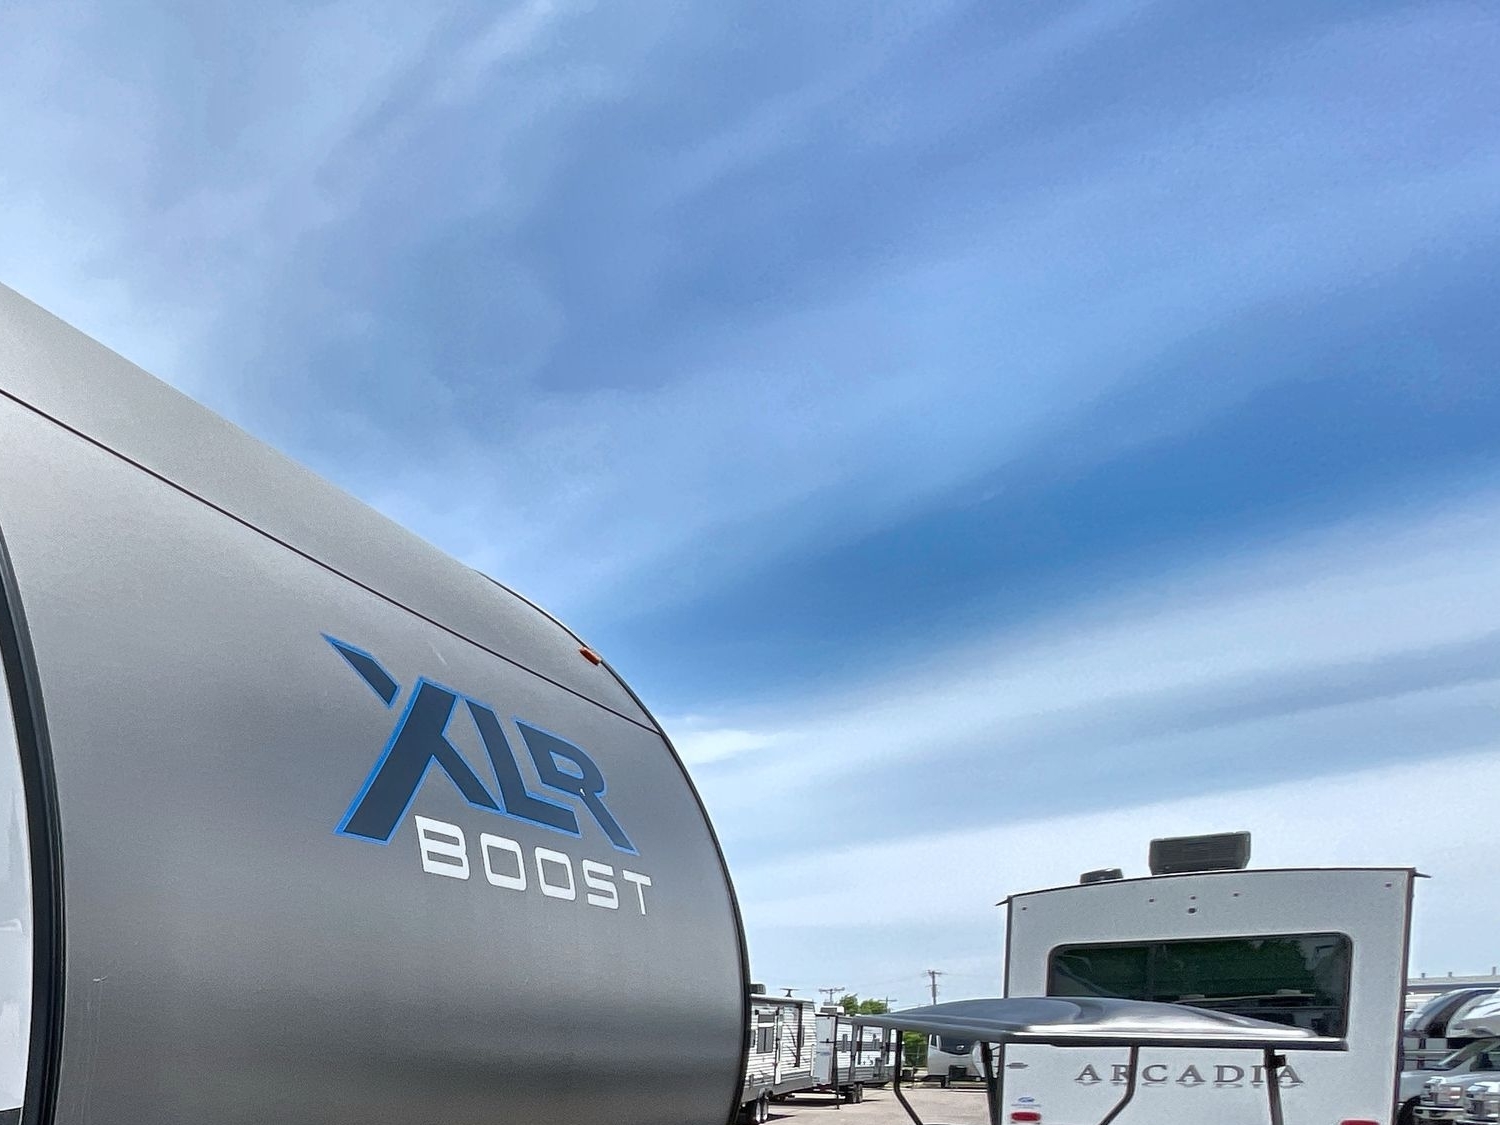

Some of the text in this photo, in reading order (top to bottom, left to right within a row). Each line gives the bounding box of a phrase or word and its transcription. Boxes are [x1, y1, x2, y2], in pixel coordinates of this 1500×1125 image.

[321, 633, 640, 856] XLR
[414, 815, 652, 915] BOOST
[1075, 1063, 1304, 1085] ARCADIA
